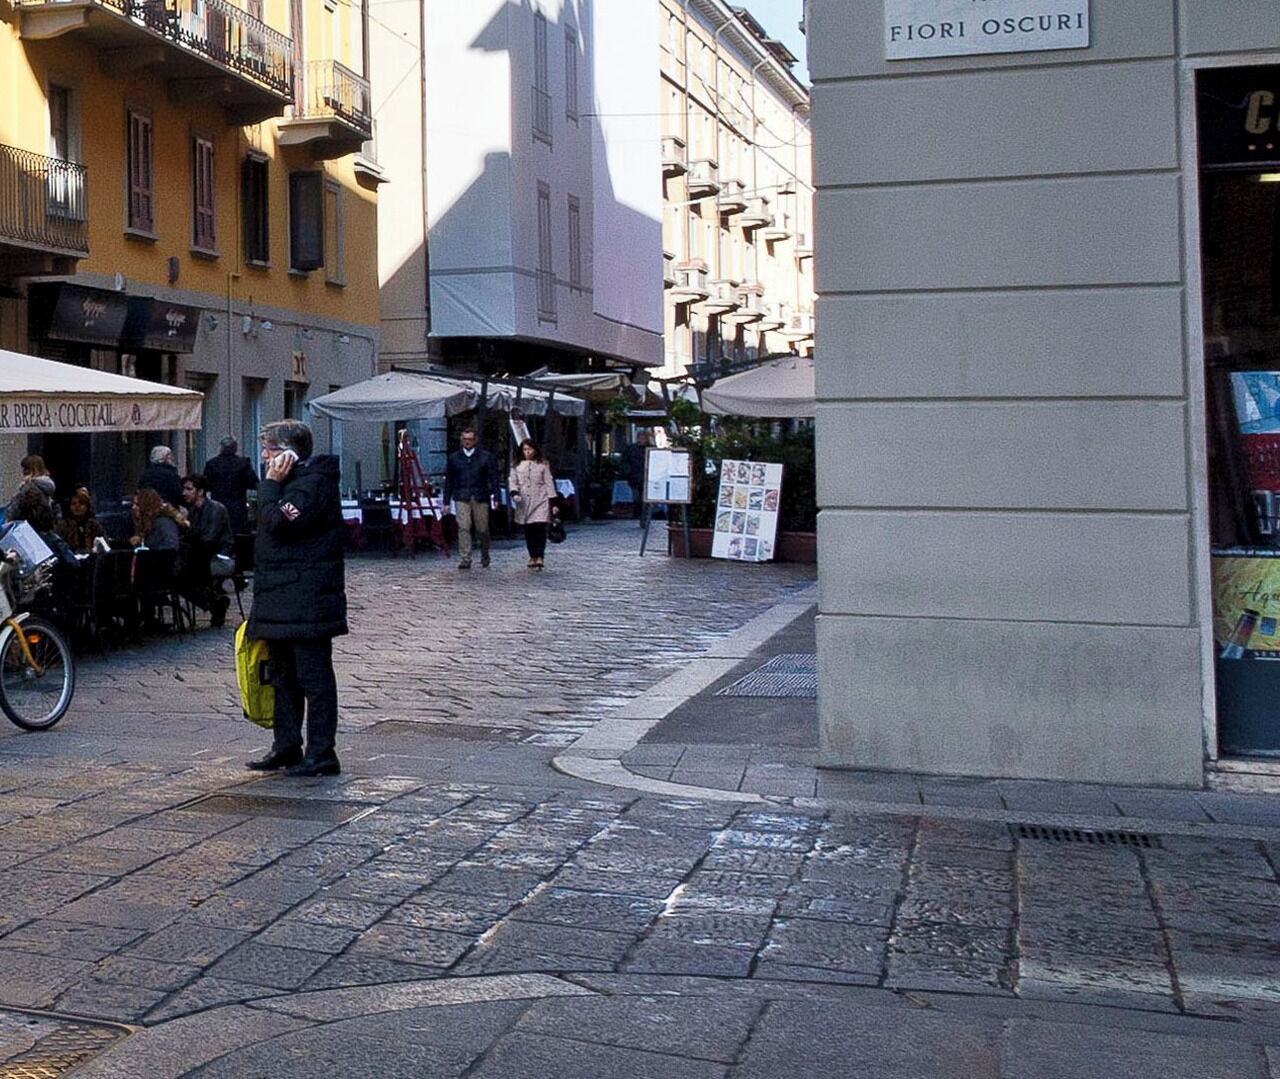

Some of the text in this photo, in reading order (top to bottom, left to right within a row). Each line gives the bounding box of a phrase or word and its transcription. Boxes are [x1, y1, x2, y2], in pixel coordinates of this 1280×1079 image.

[891, 12, 1084, 42] FIORI OSCURI
[14, 402, 51, 428] BRERA
[58, 402, 116, 427] COCKTAIL
